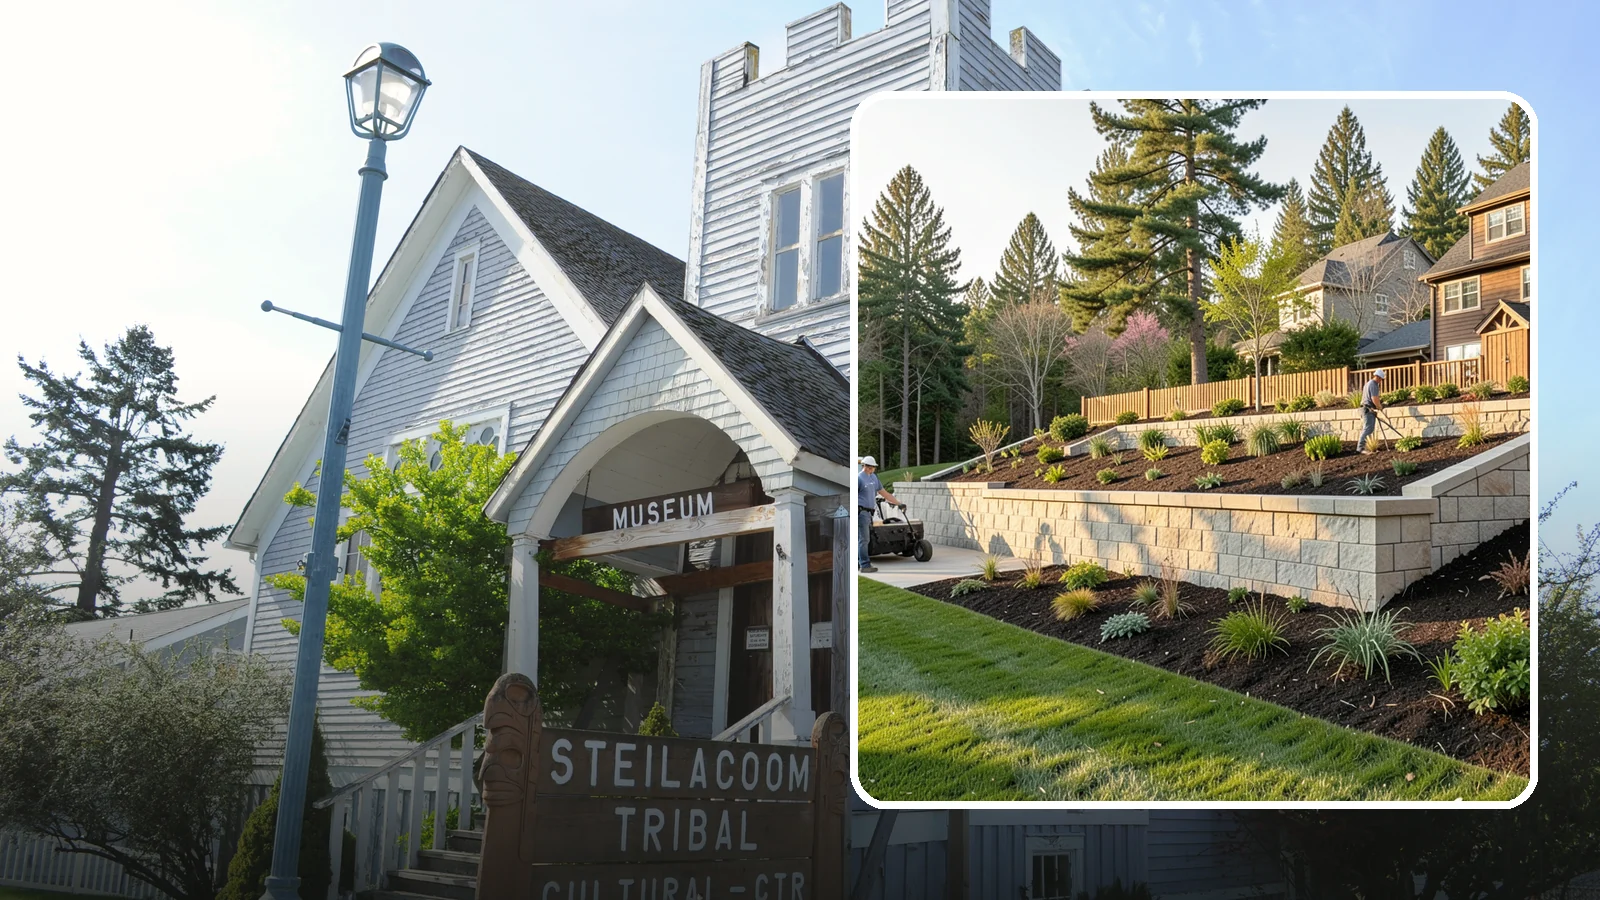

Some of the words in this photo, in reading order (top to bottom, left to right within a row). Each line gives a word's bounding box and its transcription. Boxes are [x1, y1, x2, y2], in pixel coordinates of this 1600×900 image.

[612, 491, 714, 531] MUSEUM
[550, 738, 810, 793] STEILACOOM
[615, 806, 758, 852] TRIBAL
